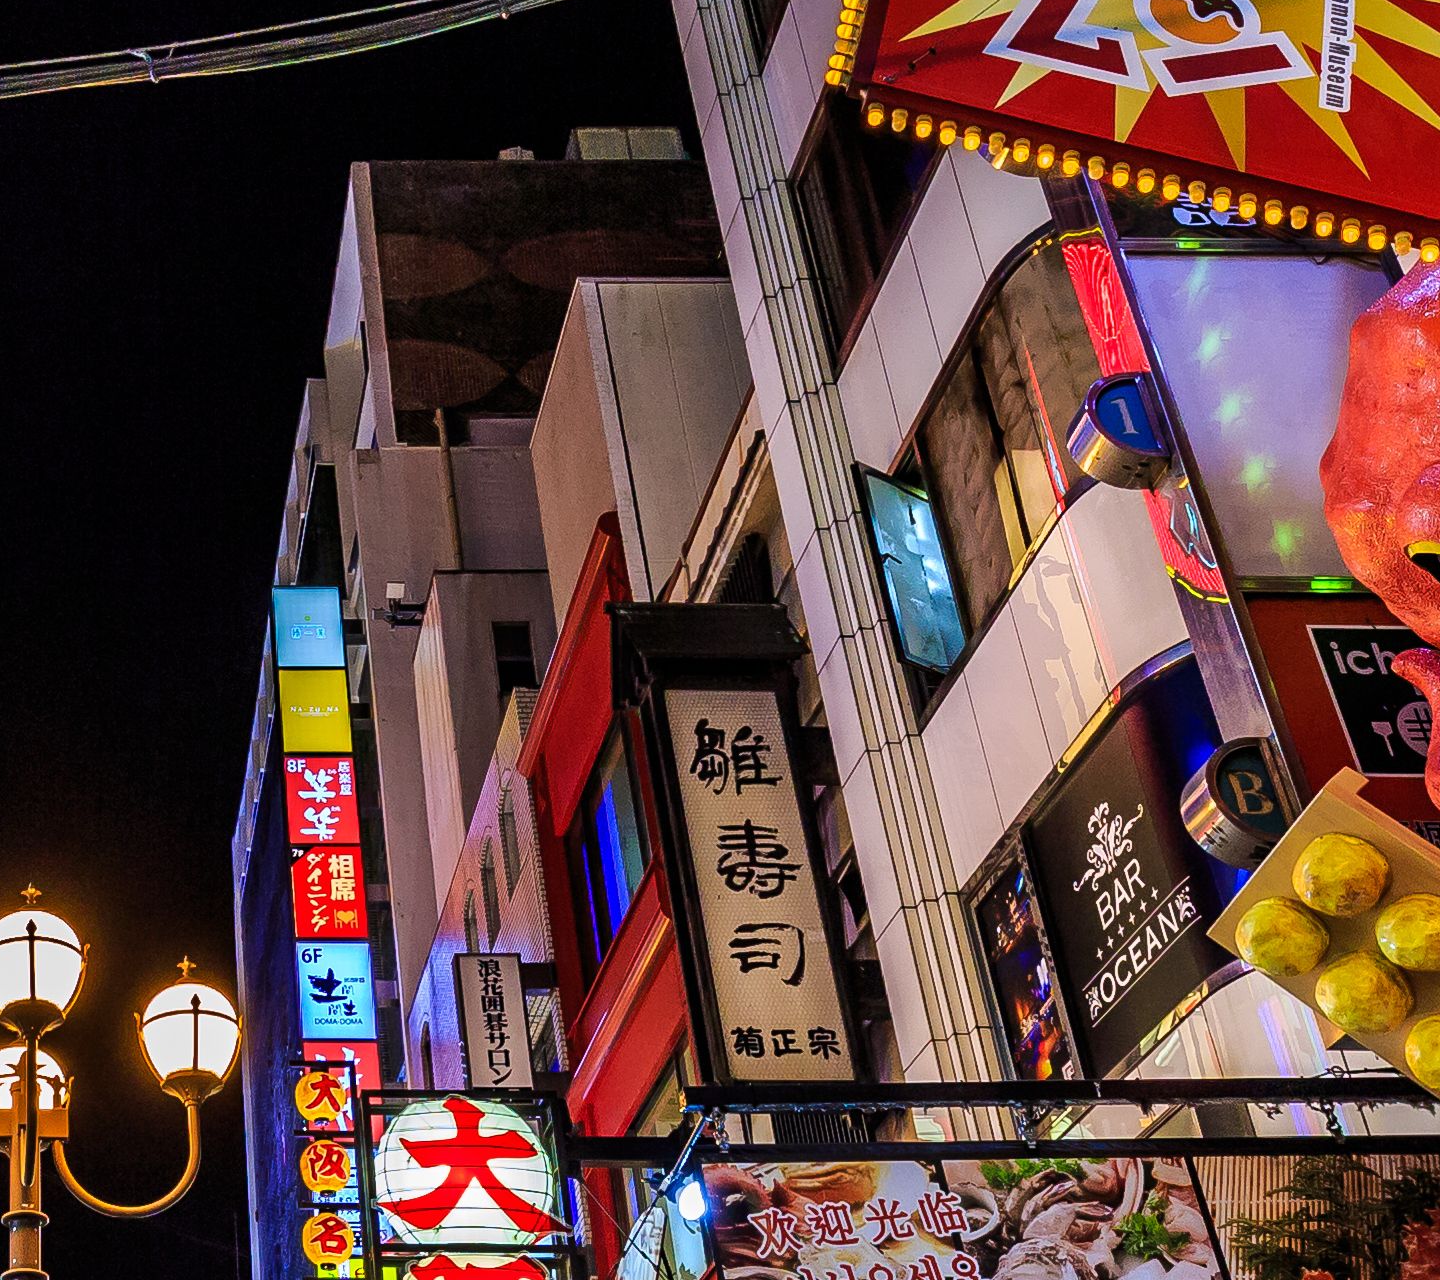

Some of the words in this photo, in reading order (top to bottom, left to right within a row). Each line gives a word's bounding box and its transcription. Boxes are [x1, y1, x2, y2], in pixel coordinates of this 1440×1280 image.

[287, 759, 307, 772] 8F
[305, 853, 329, 933] ダイニング
[328, 854, 355, 902] 相席
[1095, 862, 1148, 930] BAR
[302, 948, 323, 963] 6F
[1099, 915, 1182, 1005] OCEAN
[476, 959, 513, 1087] 浪花囲碁サロン
[731, 1027, 841, 1058] 菊正宗
[754, 1189, 967, 1258] 欢迎光临
